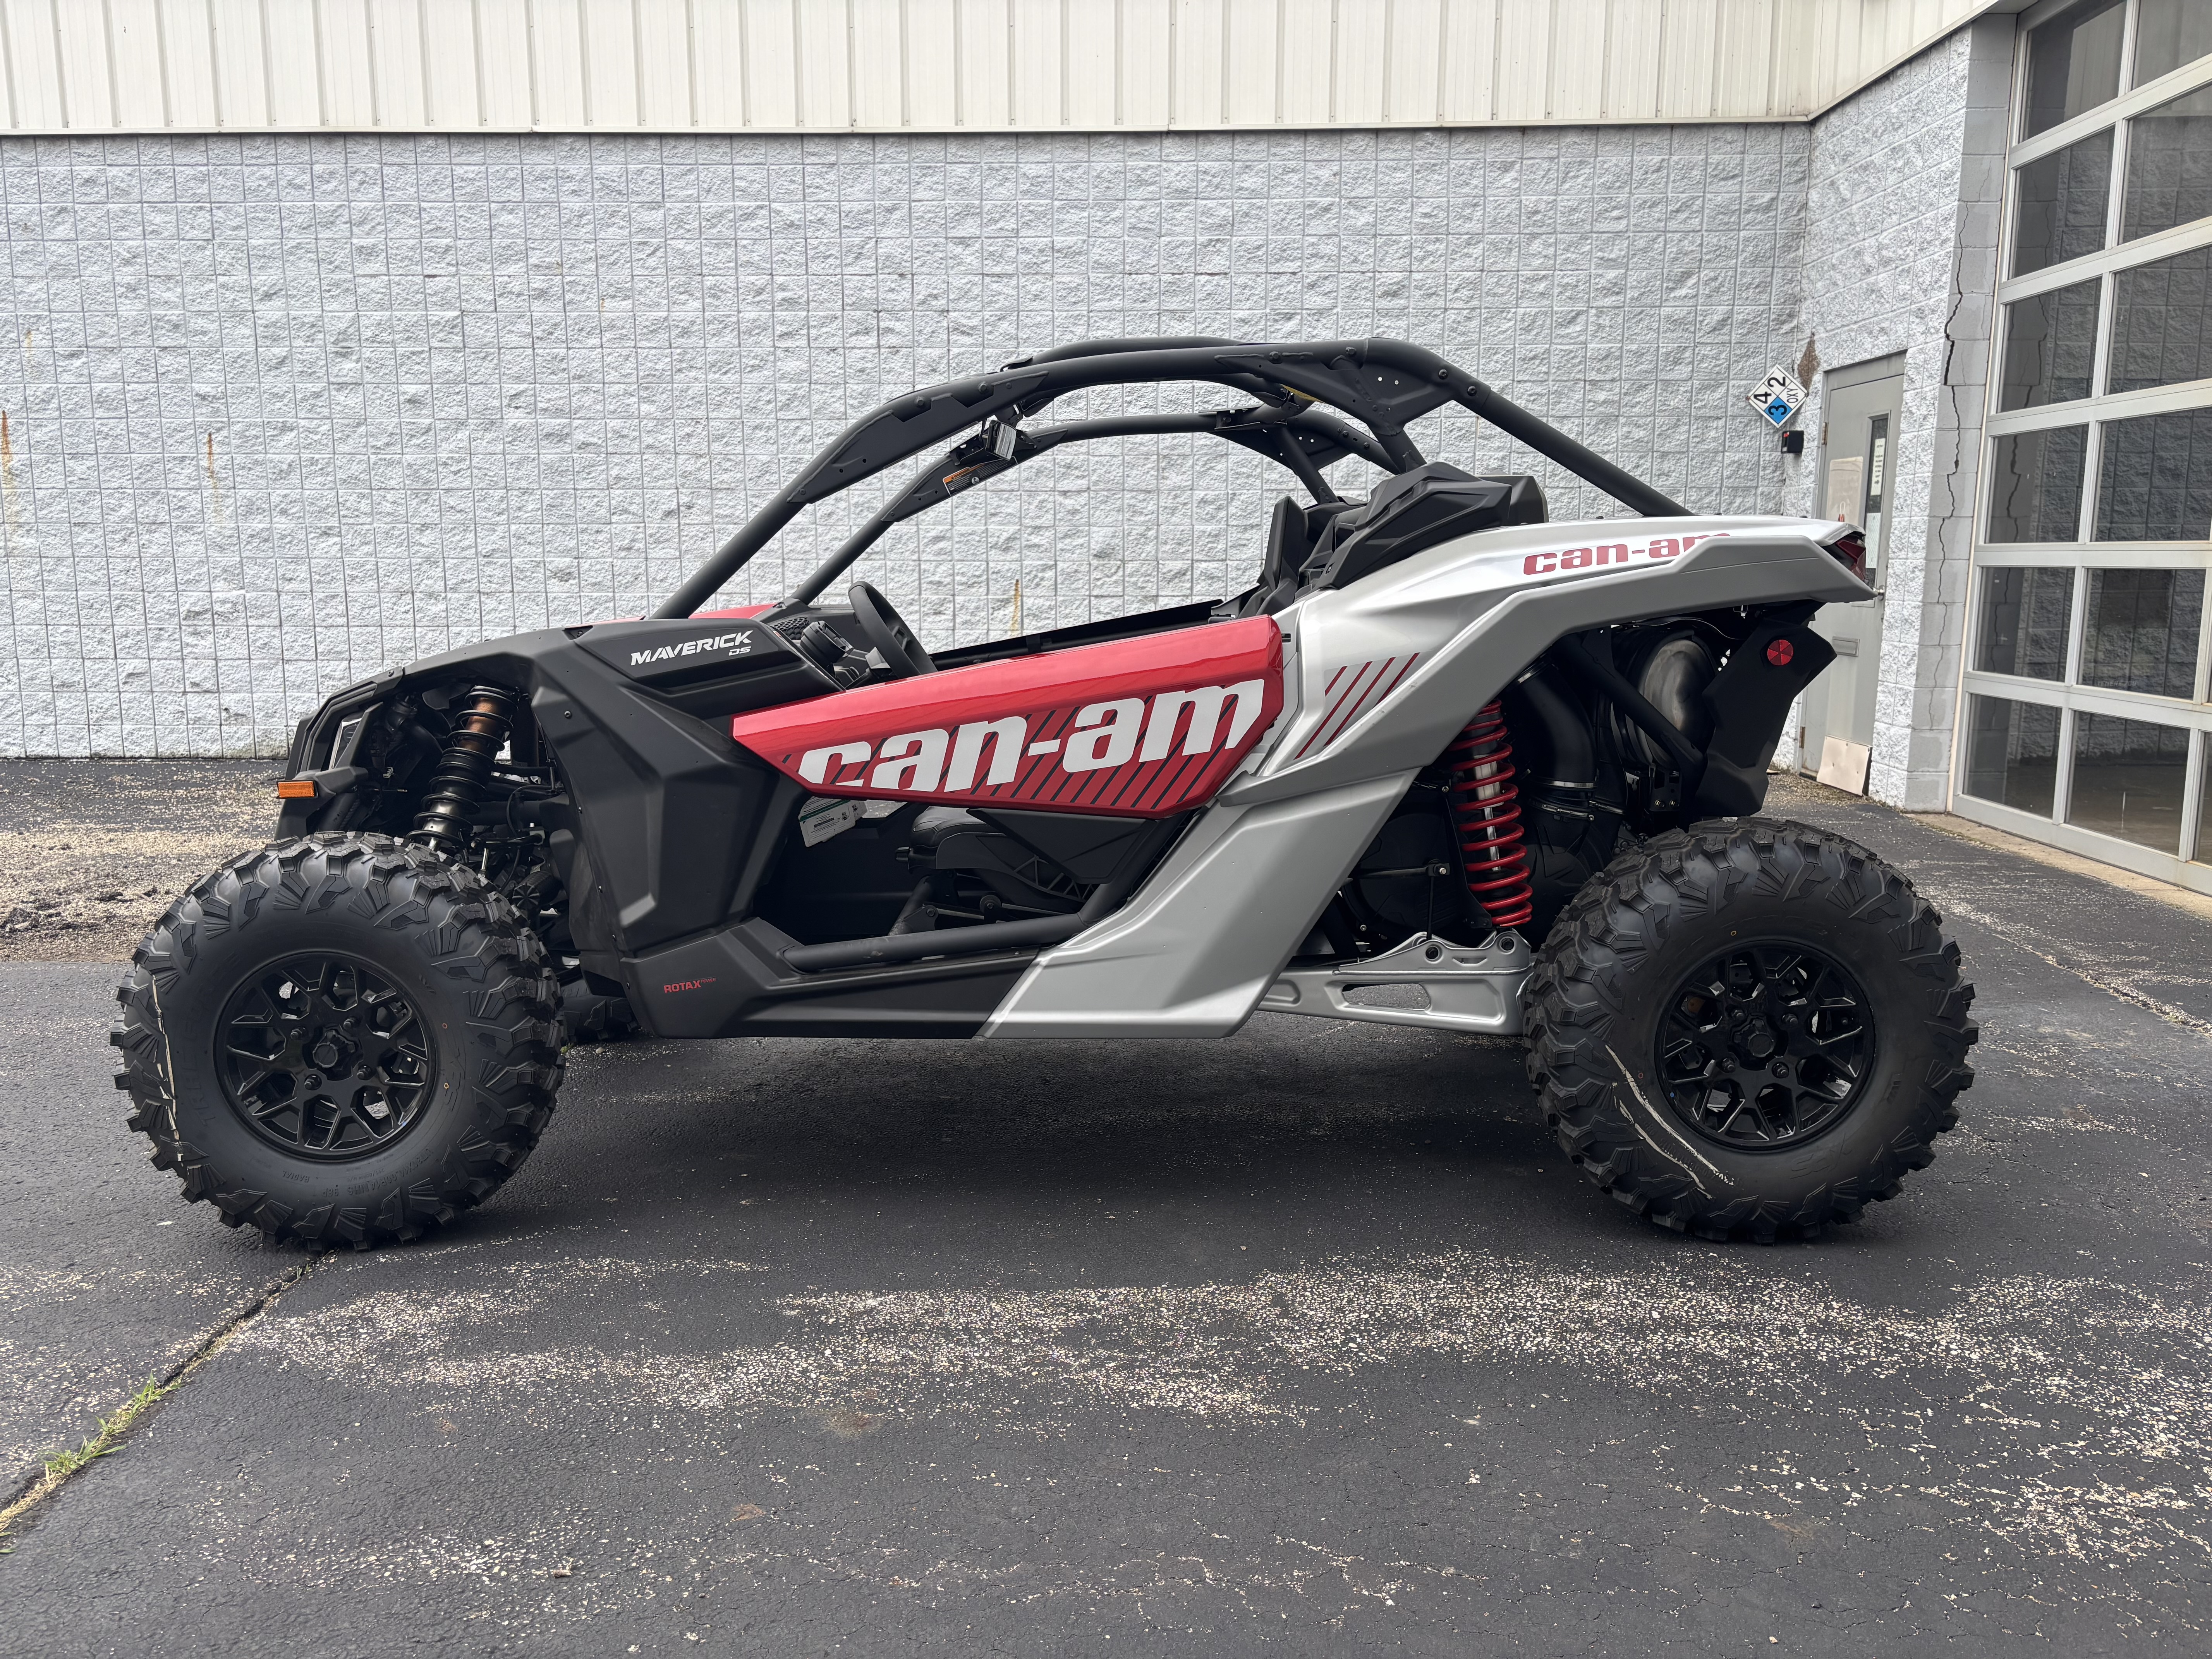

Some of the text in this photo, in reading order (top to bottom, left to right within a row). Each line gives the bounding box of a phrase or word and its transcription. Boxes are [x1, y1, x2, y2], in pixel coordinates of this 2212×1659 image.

[1767, 376, 1786, 387] 2
[1753, 392, 1772, 404] 4
[1786, 388, 1798, 403] OXY
[1768, 405, 1787, 416] 3
[631, 630, 753, 666] MAVERICK
[729, 646, 751, 656] DS
[798, 679, 1264, 792] can-am
[664, 980, 701, 993] ROTAX
